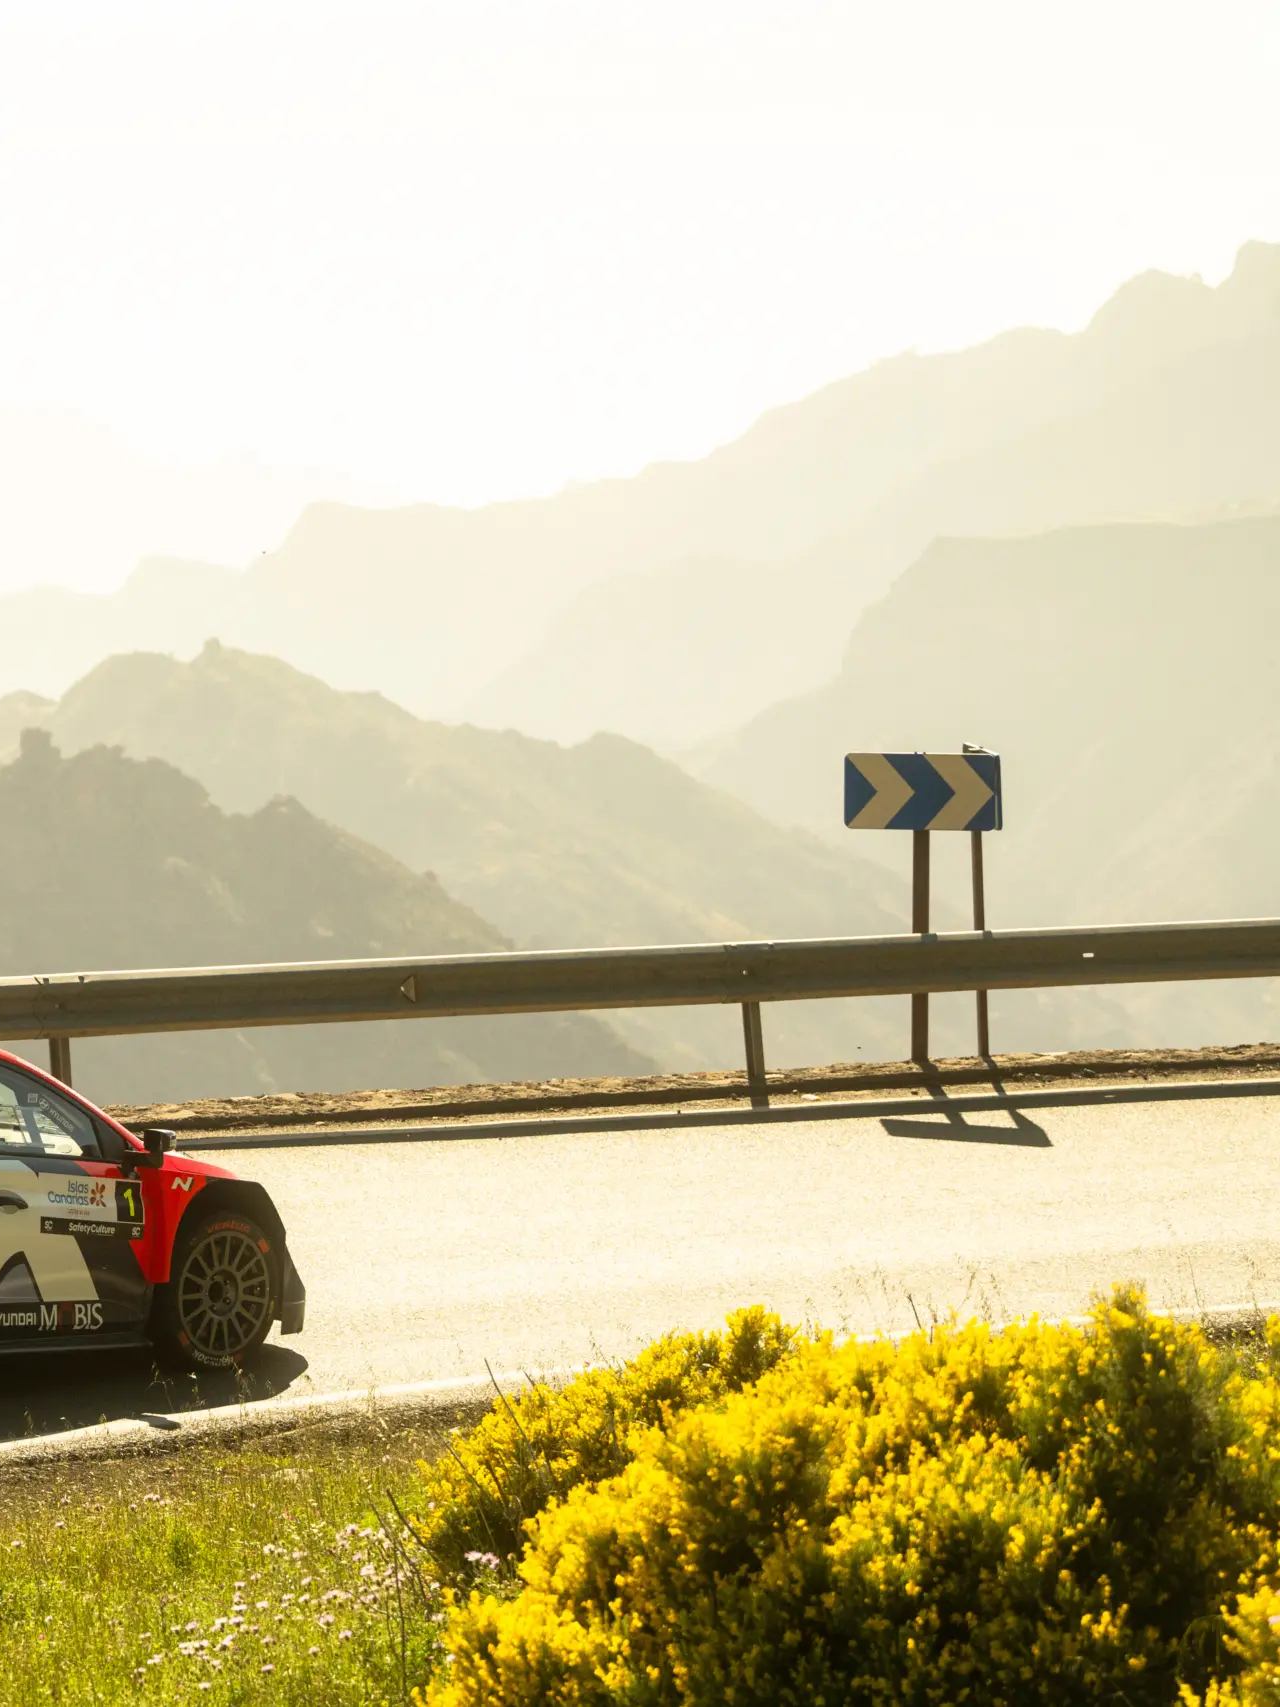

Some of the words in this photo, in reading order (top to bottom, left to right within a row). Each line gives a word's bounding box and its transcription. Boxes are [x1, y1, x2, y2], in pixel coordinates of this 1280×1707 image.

[67, 1180, 89, 1194] Islas
[47, 1191, 90, 1207] Canarias
[123, 1187, 136, 1217] 1
[44, 1220, 53, 1230] SC
[68, 1222, 116, 1236] SafetyCulture
[131, 1226, 141, 1236] SC
[38, 1302, 104, 1331] MOBIS
